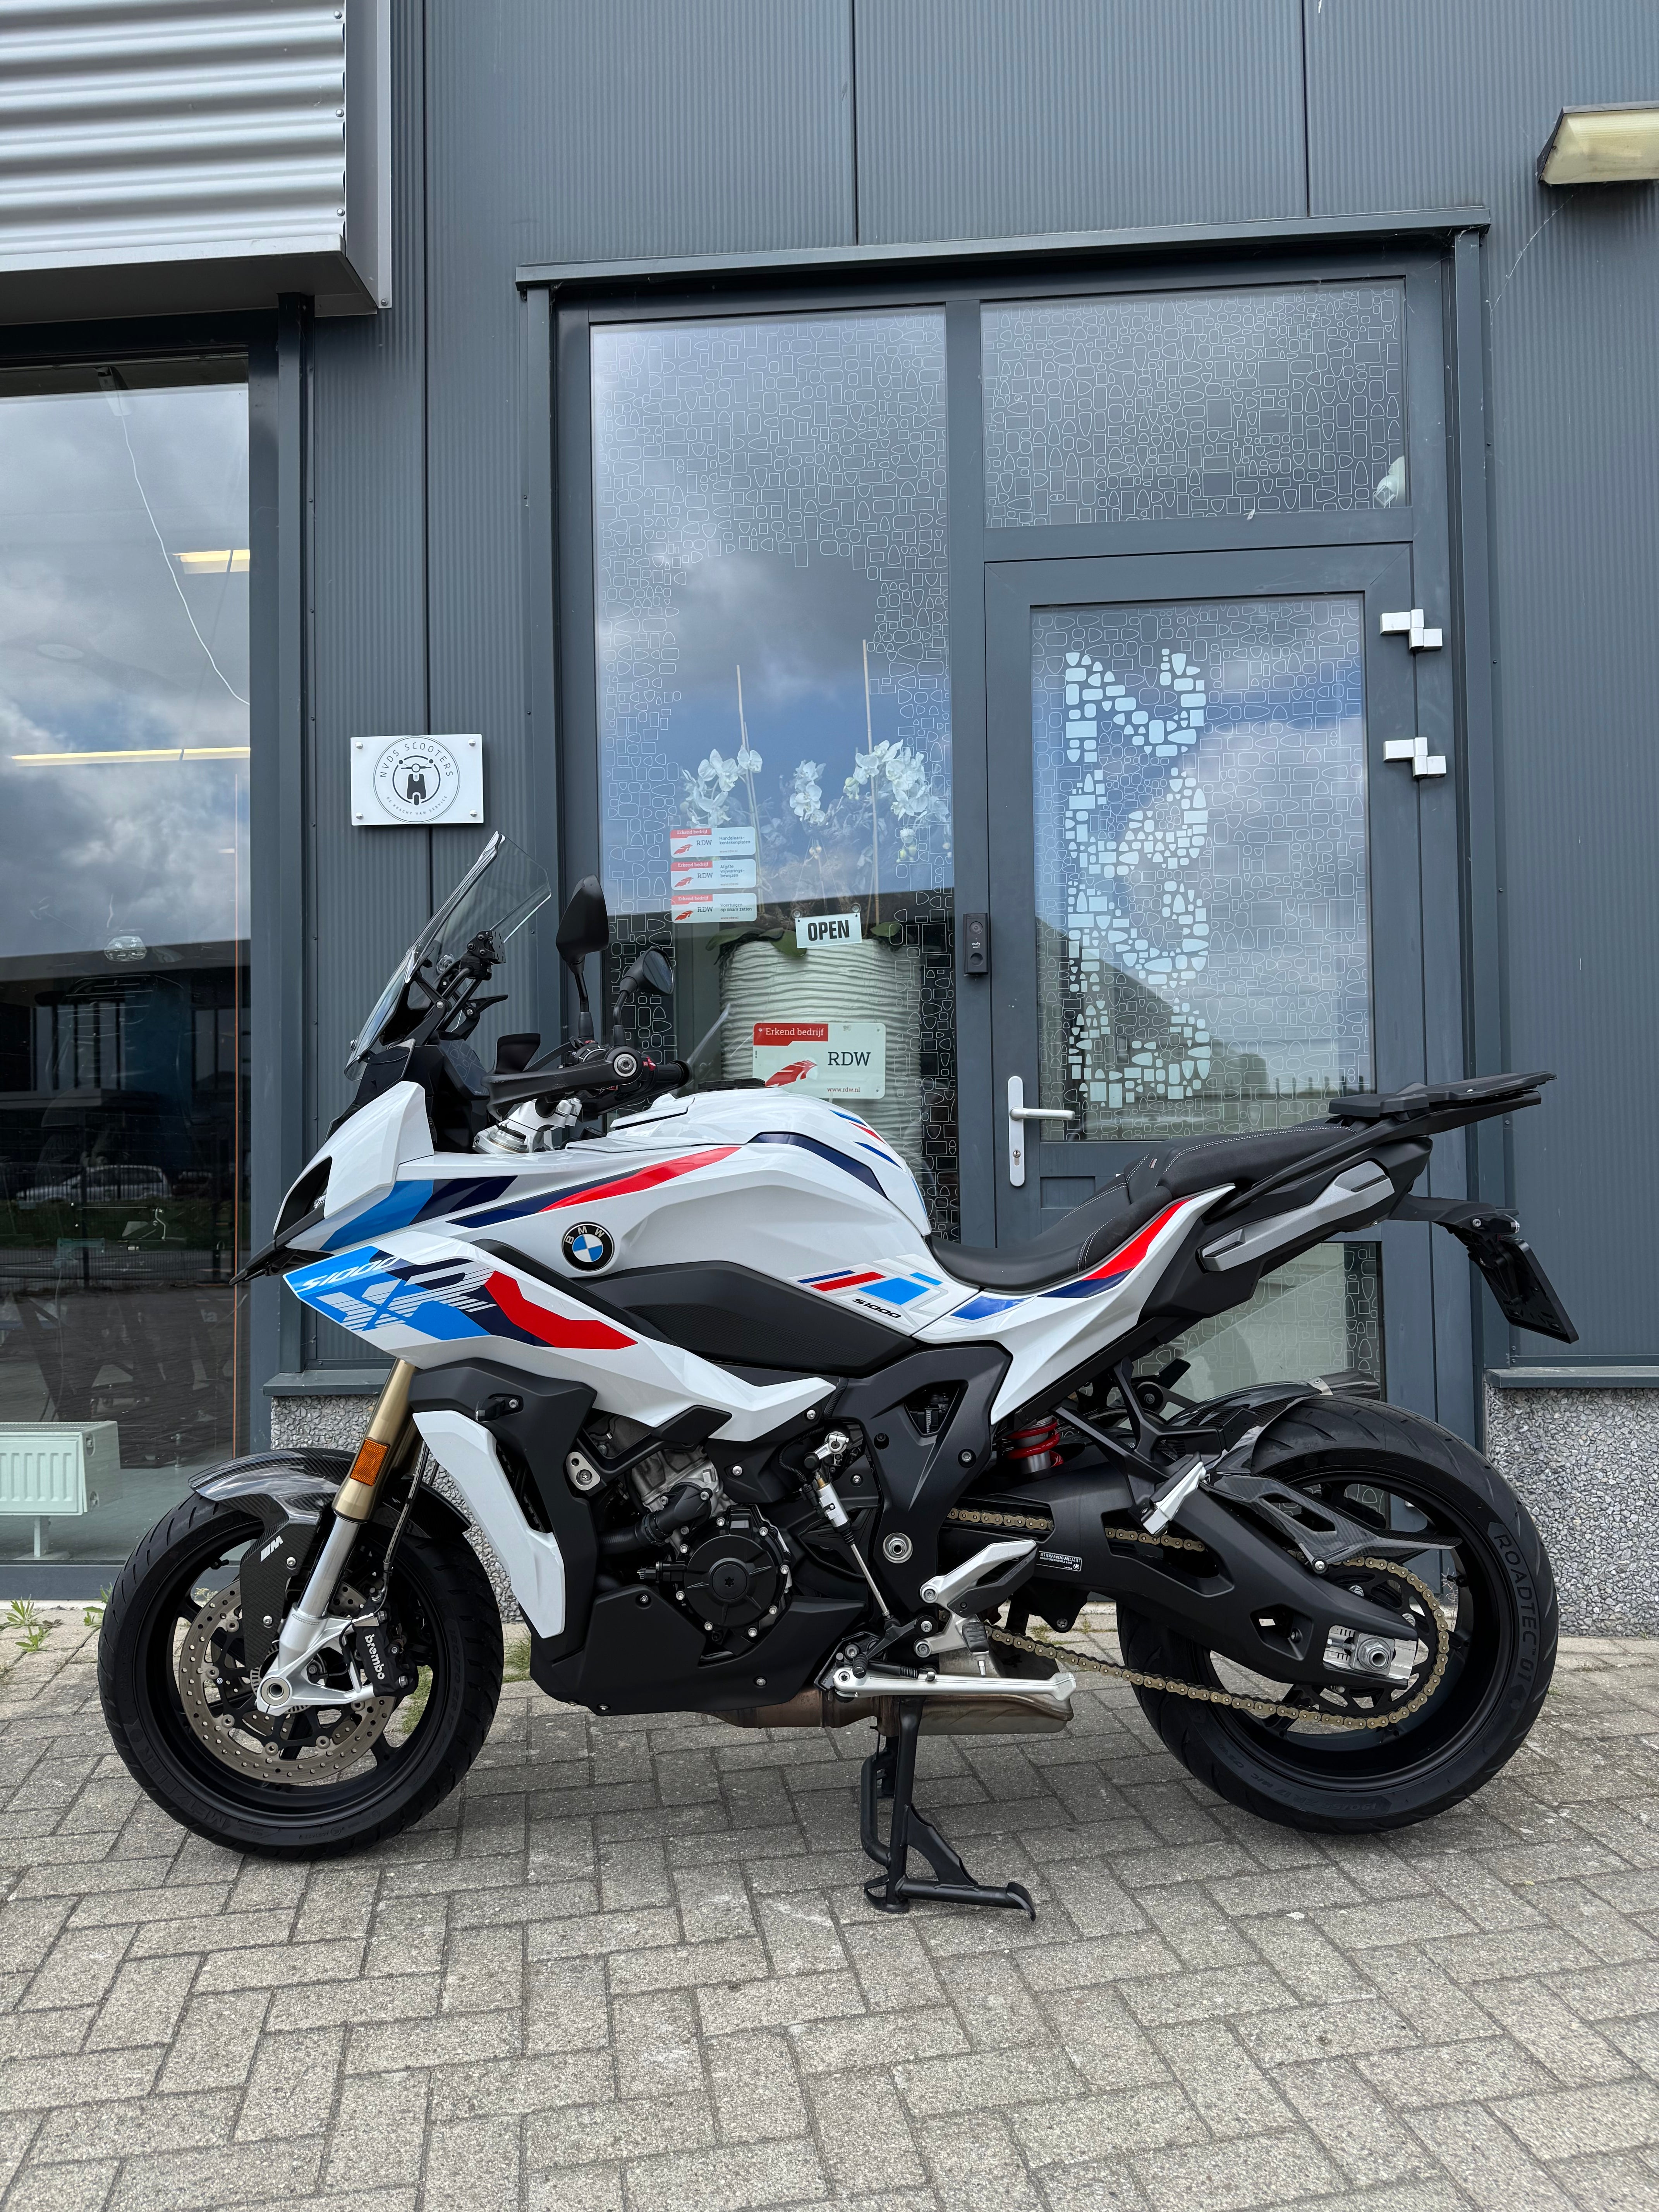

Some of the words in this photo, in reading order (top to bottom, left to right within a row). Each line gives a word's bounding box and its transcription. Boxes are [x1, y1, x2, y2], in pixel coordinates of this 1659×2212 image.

[380, 750, 399, 778] NVDS
[405, 742, 453, 776] SCOOTERS
[393, 804, 412, 815] KRACHT
[429, 795, 448, 812] SERVICE
[807, 920, 850, 941] OPEN
[797, 1028, 824, 1037] bedrijf
[828, 1052, 871, 1066] RDW
[565, 1226, 605, 1245] BMW
[301, 1257, 400, 1291] S1000
[852, 1298, 902, 1319] S1000
[364, 1634, 385, 1680] brembo
[139, 1745, 227, 1828] METZELER
